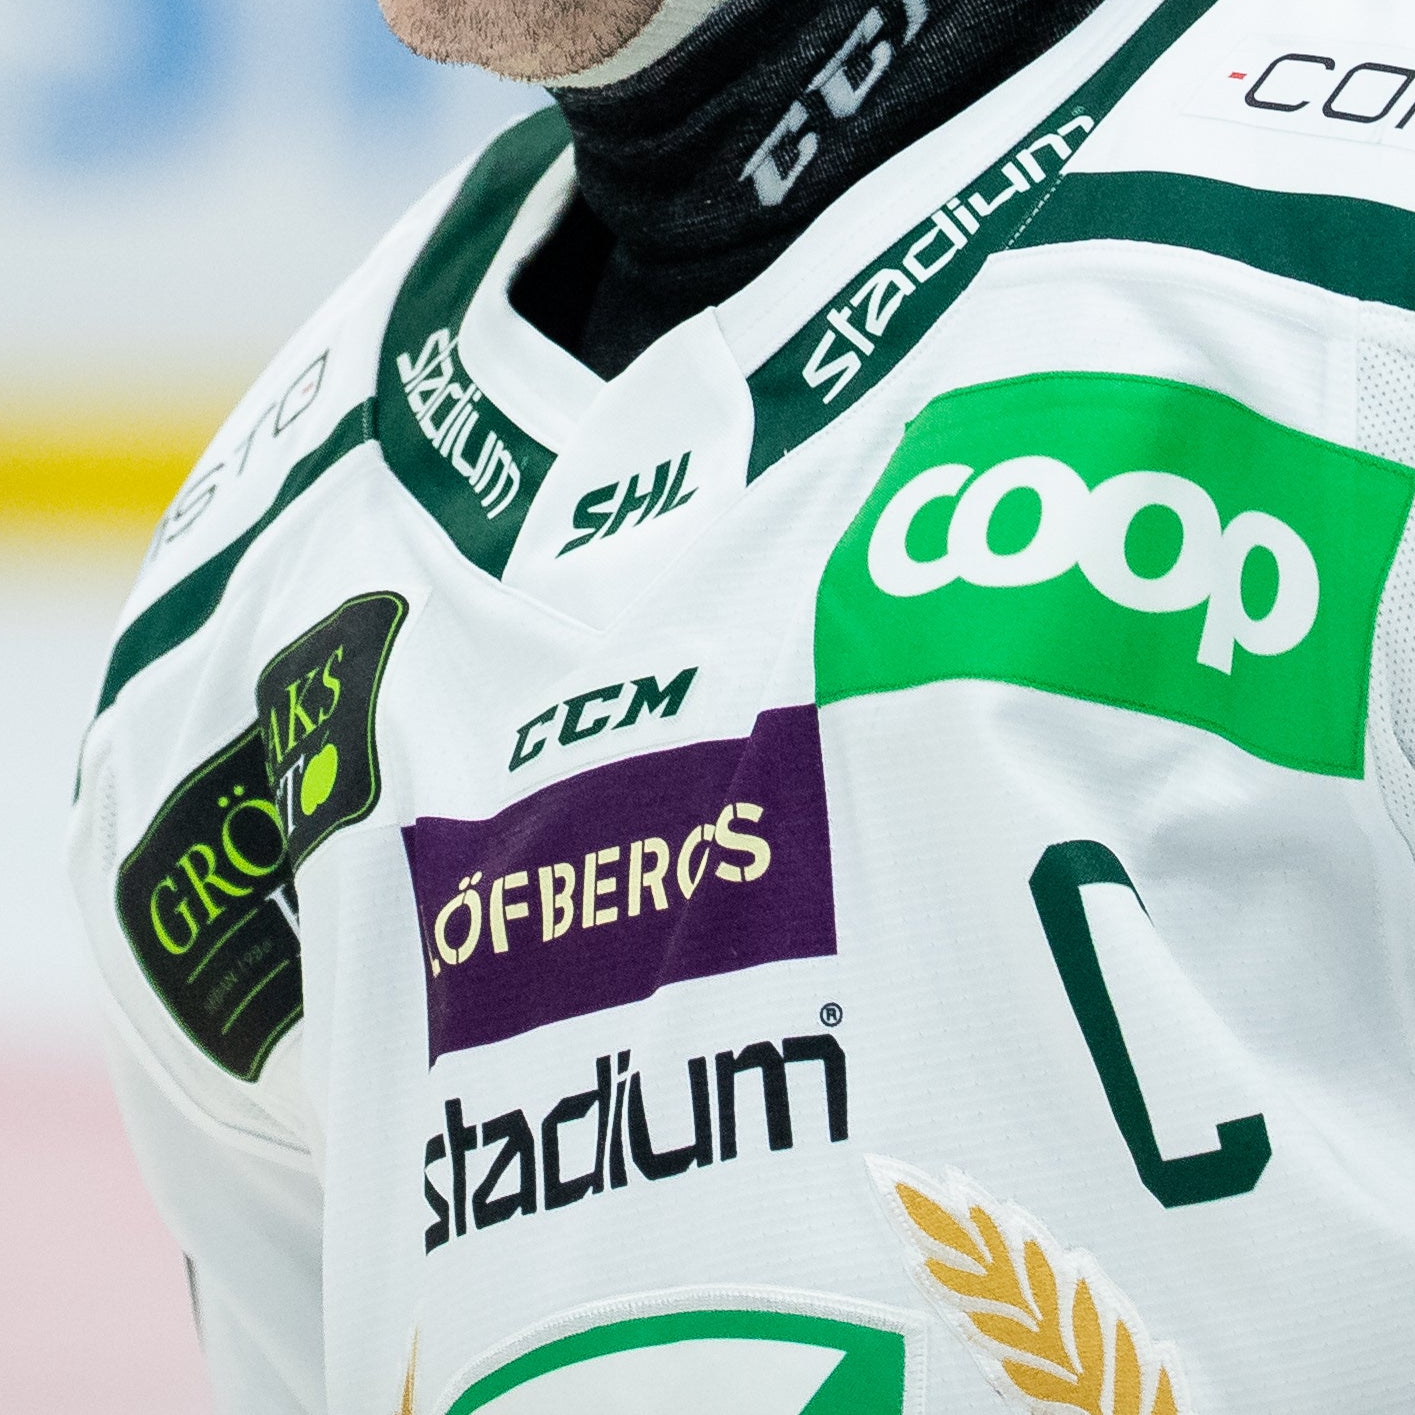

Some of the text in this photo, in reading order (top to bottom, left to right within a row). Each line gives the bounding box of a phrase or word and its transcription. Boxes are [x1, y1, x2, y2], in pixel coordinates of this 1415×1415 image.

[801, 114, 1095, 407] stadium
[396, 327, 521, 521] stadium
[554, 450, 700, 560] SHL
[867, 454, 1320, 676] coop
[508, 665, 700, 773] CCM
[421, 801, 772, 978] ÖFBERS
[1028, 839, 1272, 1209] C
